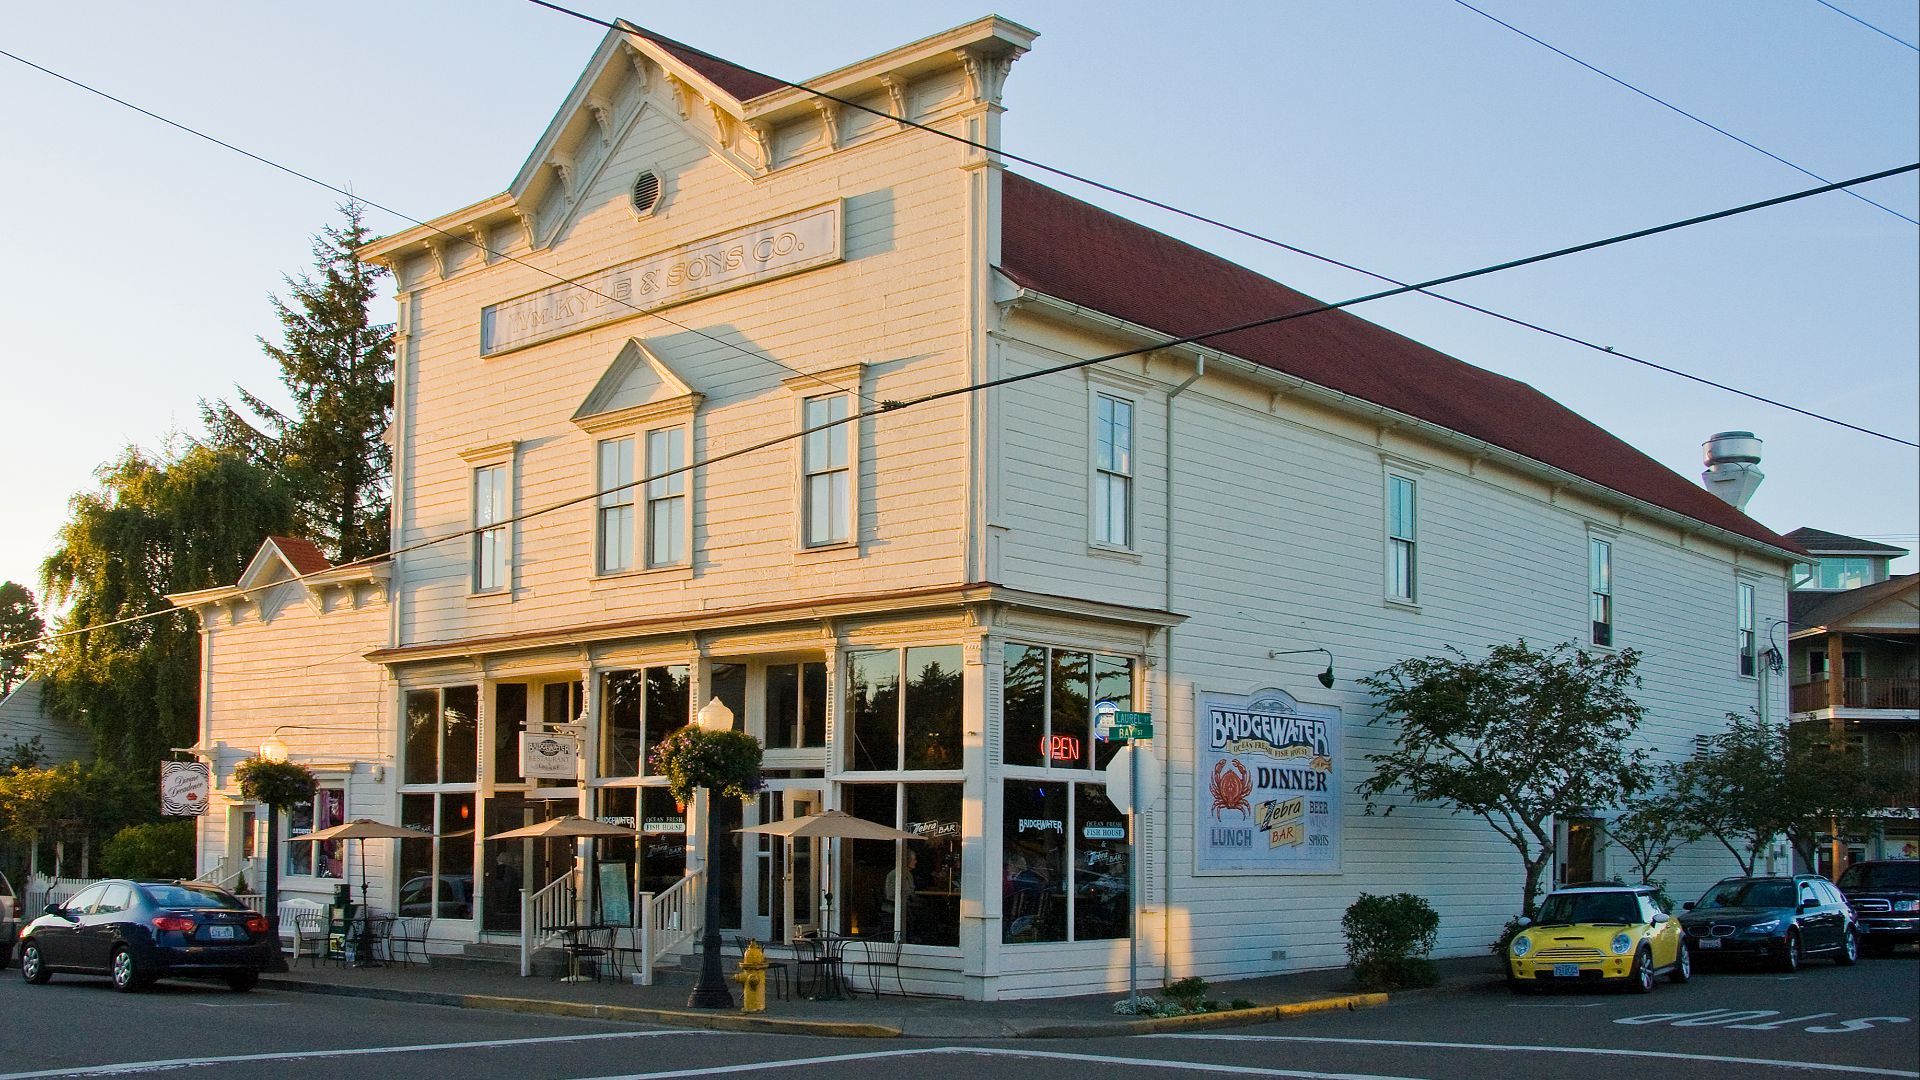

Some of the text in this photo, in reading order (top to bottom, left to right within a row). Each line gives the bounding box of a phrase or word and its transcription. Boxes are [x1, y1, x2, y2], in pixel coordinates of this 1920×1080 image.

[555, 278, 633, 321] KYLE
[640, 269, 661, 296] &
[666, 245, 744, 288] SONS
[753, 231, 805, 263] CO.
[1116, 713, 1141, 725] LAUREL
[1119, 725, 1134, 738] BAY
[1211, 710, 1330, 757] BRIDGEWATER
[1040, 735, 1079, 760] OPEN
[1233, 742, 1253, 753] OCEAN
[1257, 767, 1327, 792] DINNER
[1309, 801, 1328, 814] BEER
[1260, 799, 1301, 832] Zebra
[913, 822, 956, 836] Zebra BAR
[1018, 819, 1063, 834] BRIDGEWATER
[1102, 829, 1123, 837] HOUSE
[1212, 828, 1252, 846] LUNCH
[1272, 826, 1294, 843] BAR
[1109, 853, 1123, 863] BAR
